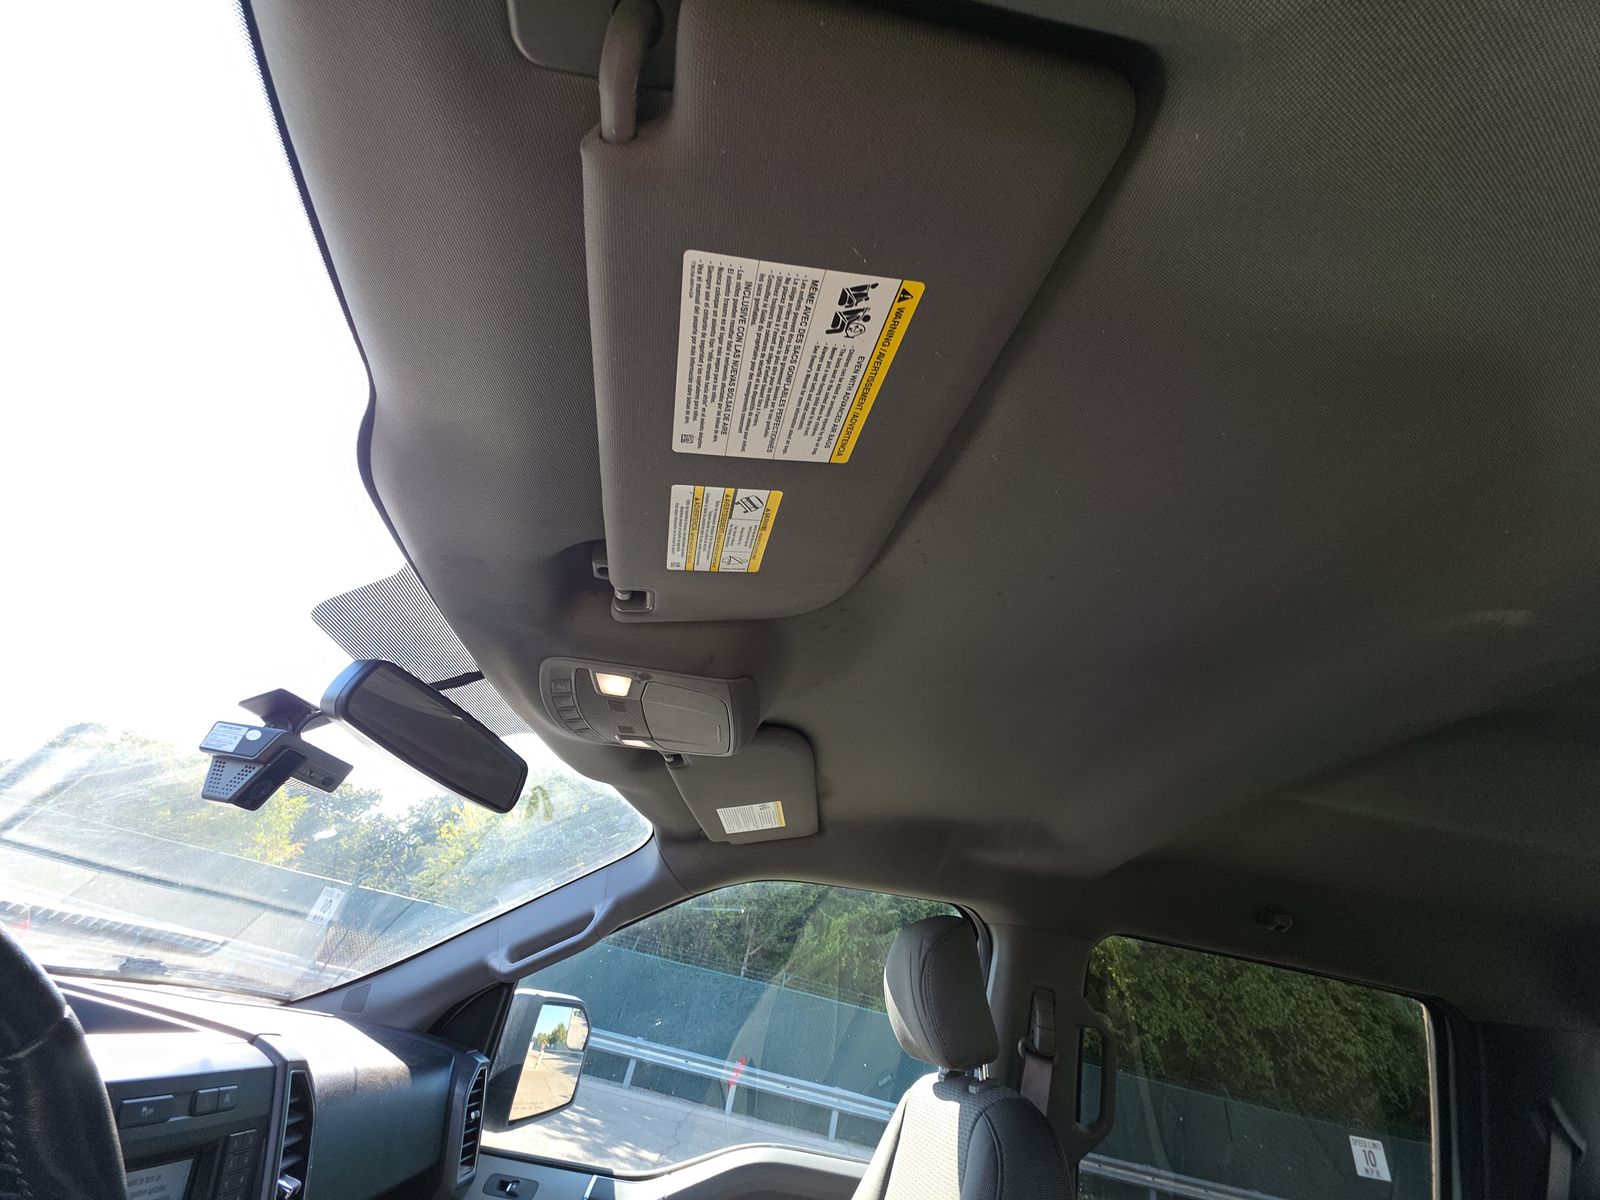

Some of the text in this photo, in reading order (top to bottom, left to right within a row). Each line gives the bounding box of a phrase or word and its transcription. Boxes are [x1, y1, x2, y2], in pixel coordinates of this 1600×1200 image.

[798, 305, 812, 327] AVEC
[880, 306, 905, 347] WARNING
[794, 328, 806, 343] DES
[720, 280, 752, 435] INCLUSIVE CON LAS NUEVAS BOLSAS DE AIRE
[789, 344, 801, 364] SACS
[777, 365, 796, 407] GONFLABLES
[823, 355, 865, 448] EVEN WITH ADVANCED AIR BAGS
[1362, 1149, 1376, 1167] 10
